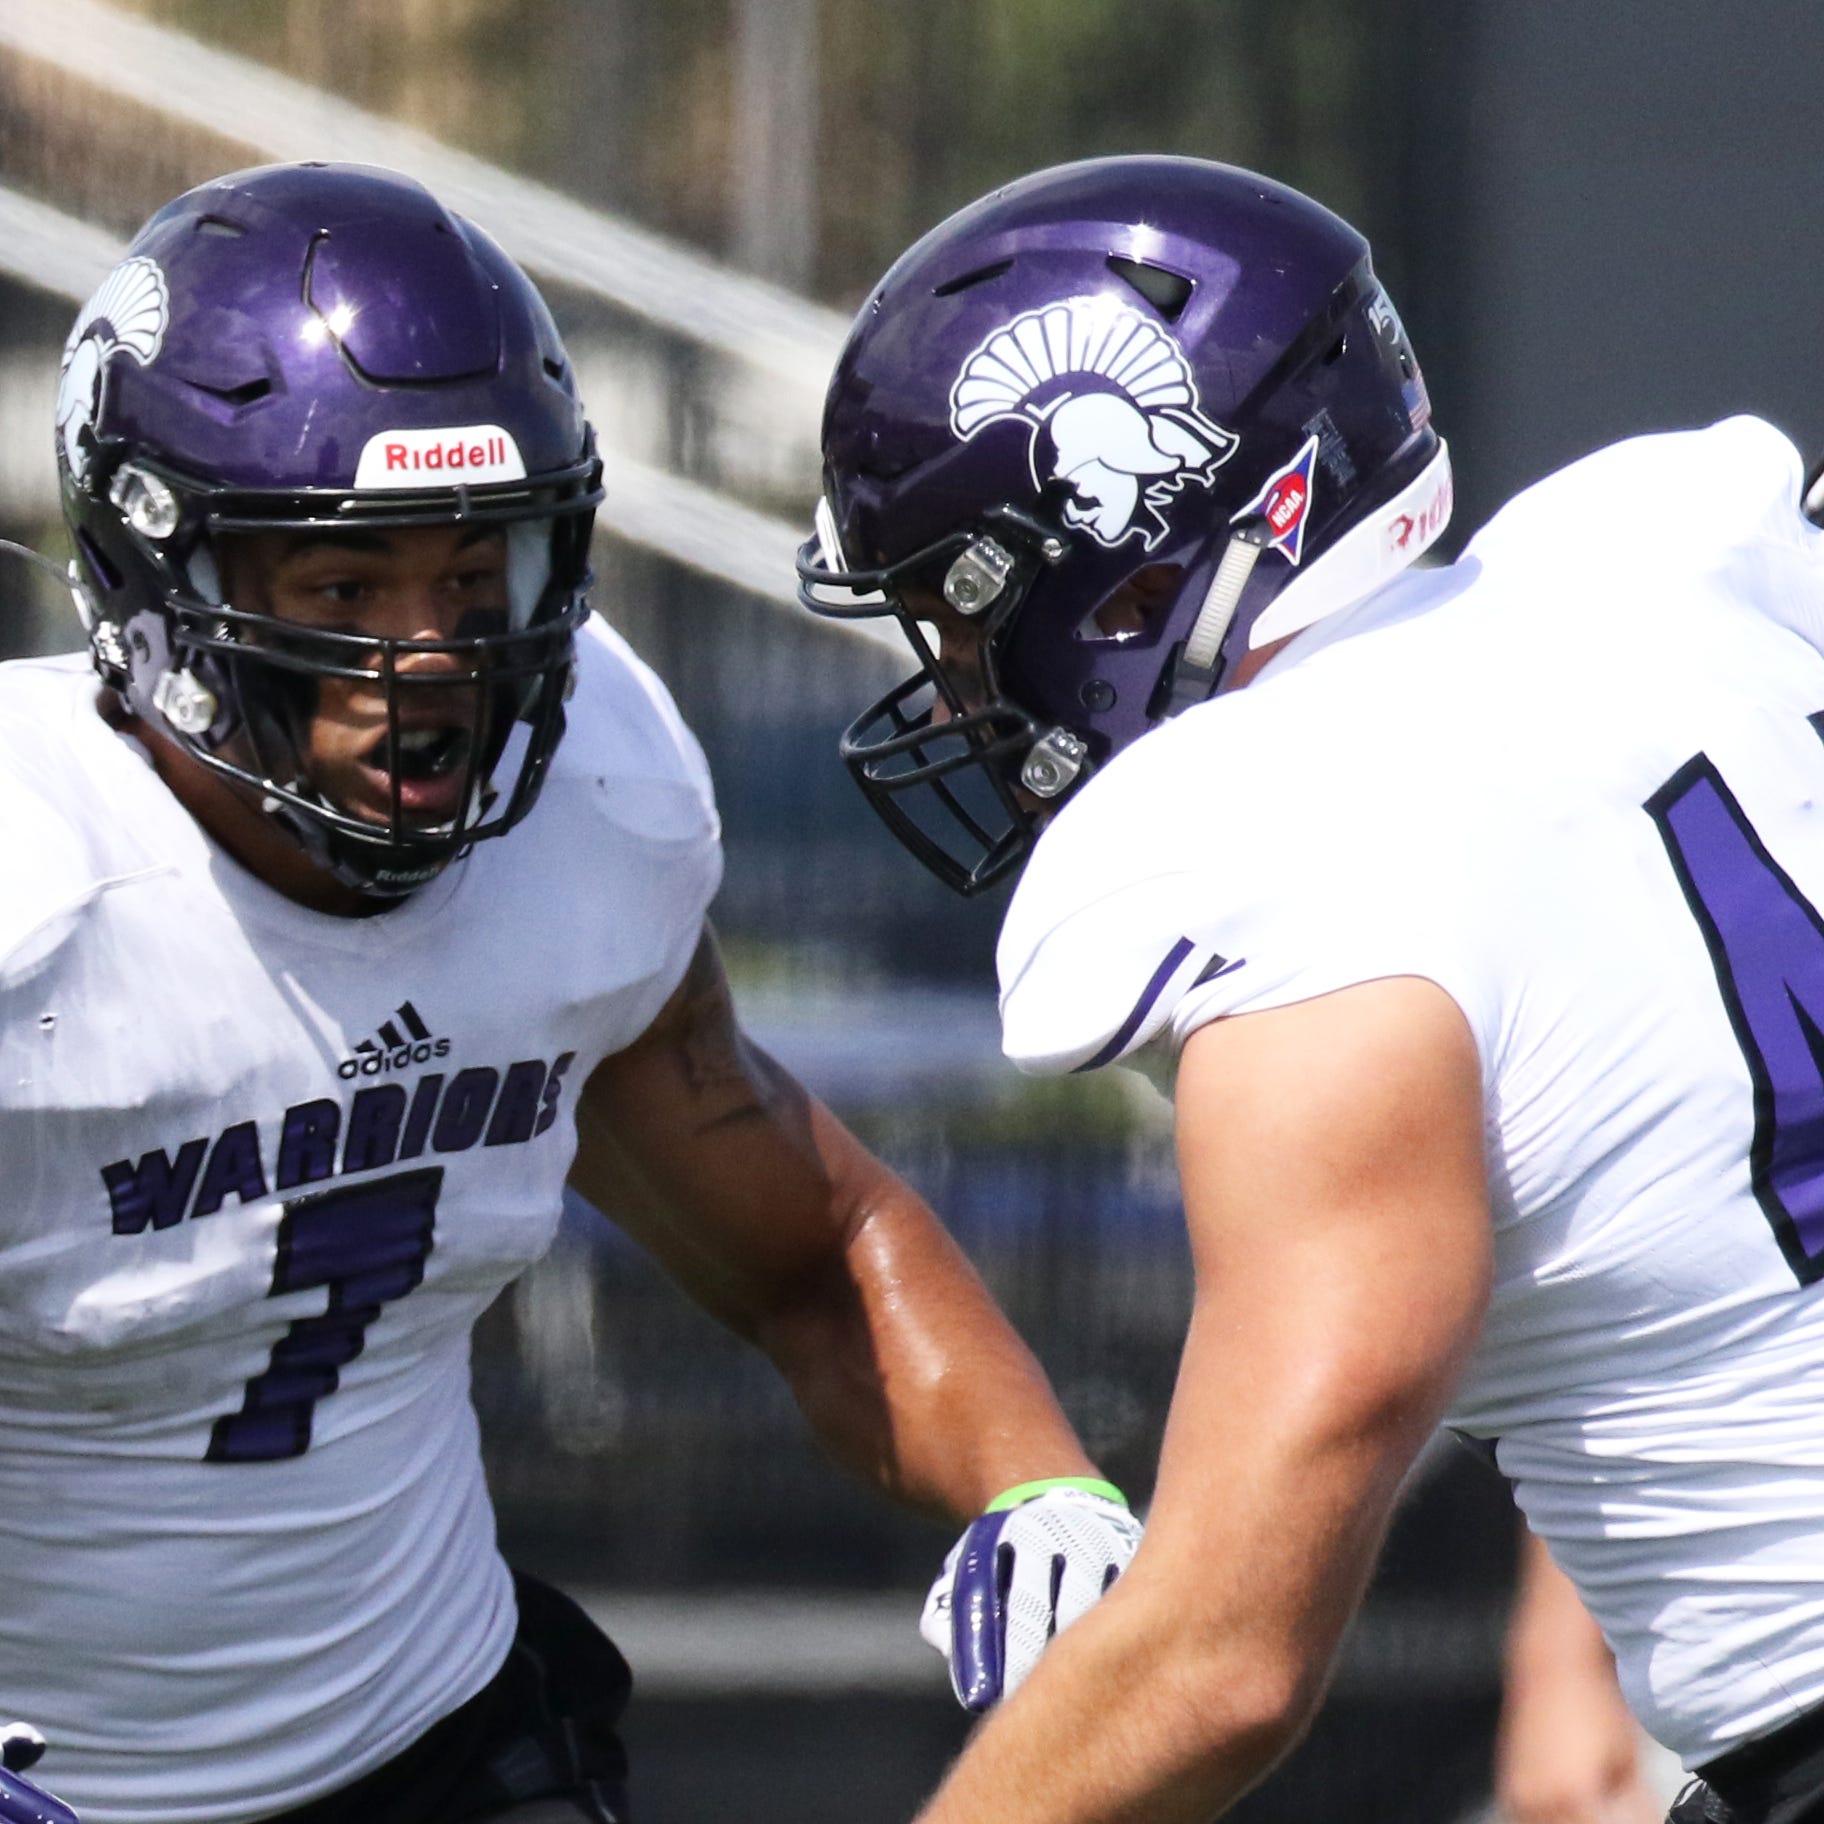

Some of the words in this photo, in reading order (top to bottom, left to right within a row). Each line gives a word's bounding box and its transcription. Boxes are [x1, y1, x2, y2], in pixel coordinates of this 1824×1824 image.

[384, 436, 506, 471] Riddell
[1271, 489, 1303, 529] NCAA
[336, 1036, 452, 1082] adidas
[100, 1050, 577, 1236] WARRIORS
[202, 1165, 445, 1464] 7
